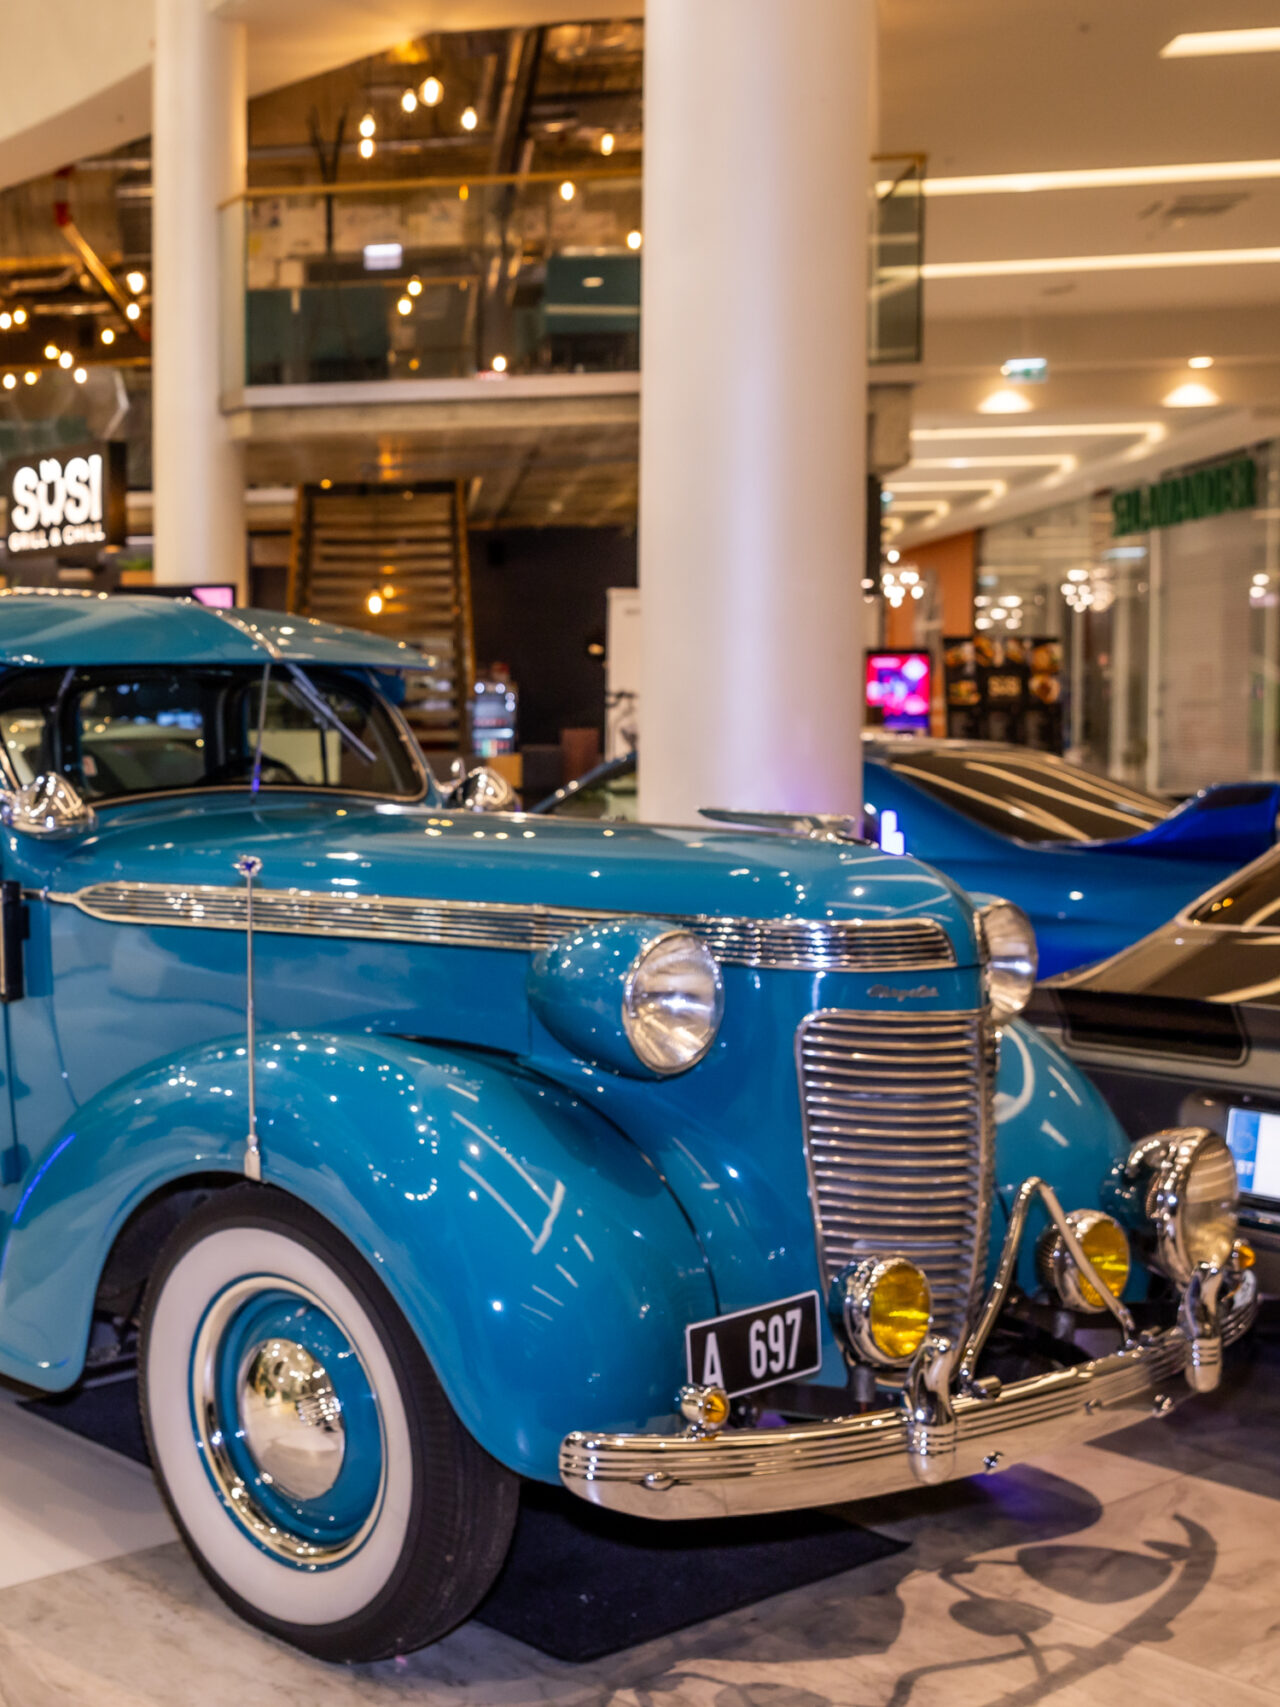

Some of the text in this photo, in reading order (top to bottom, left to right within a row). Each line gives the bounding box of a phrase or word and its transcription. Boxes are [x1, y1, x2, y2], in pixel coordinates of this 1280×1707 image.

[1236, 1160, 1255, 1175] ST
[703, 1307, 802, 1389] A 697
